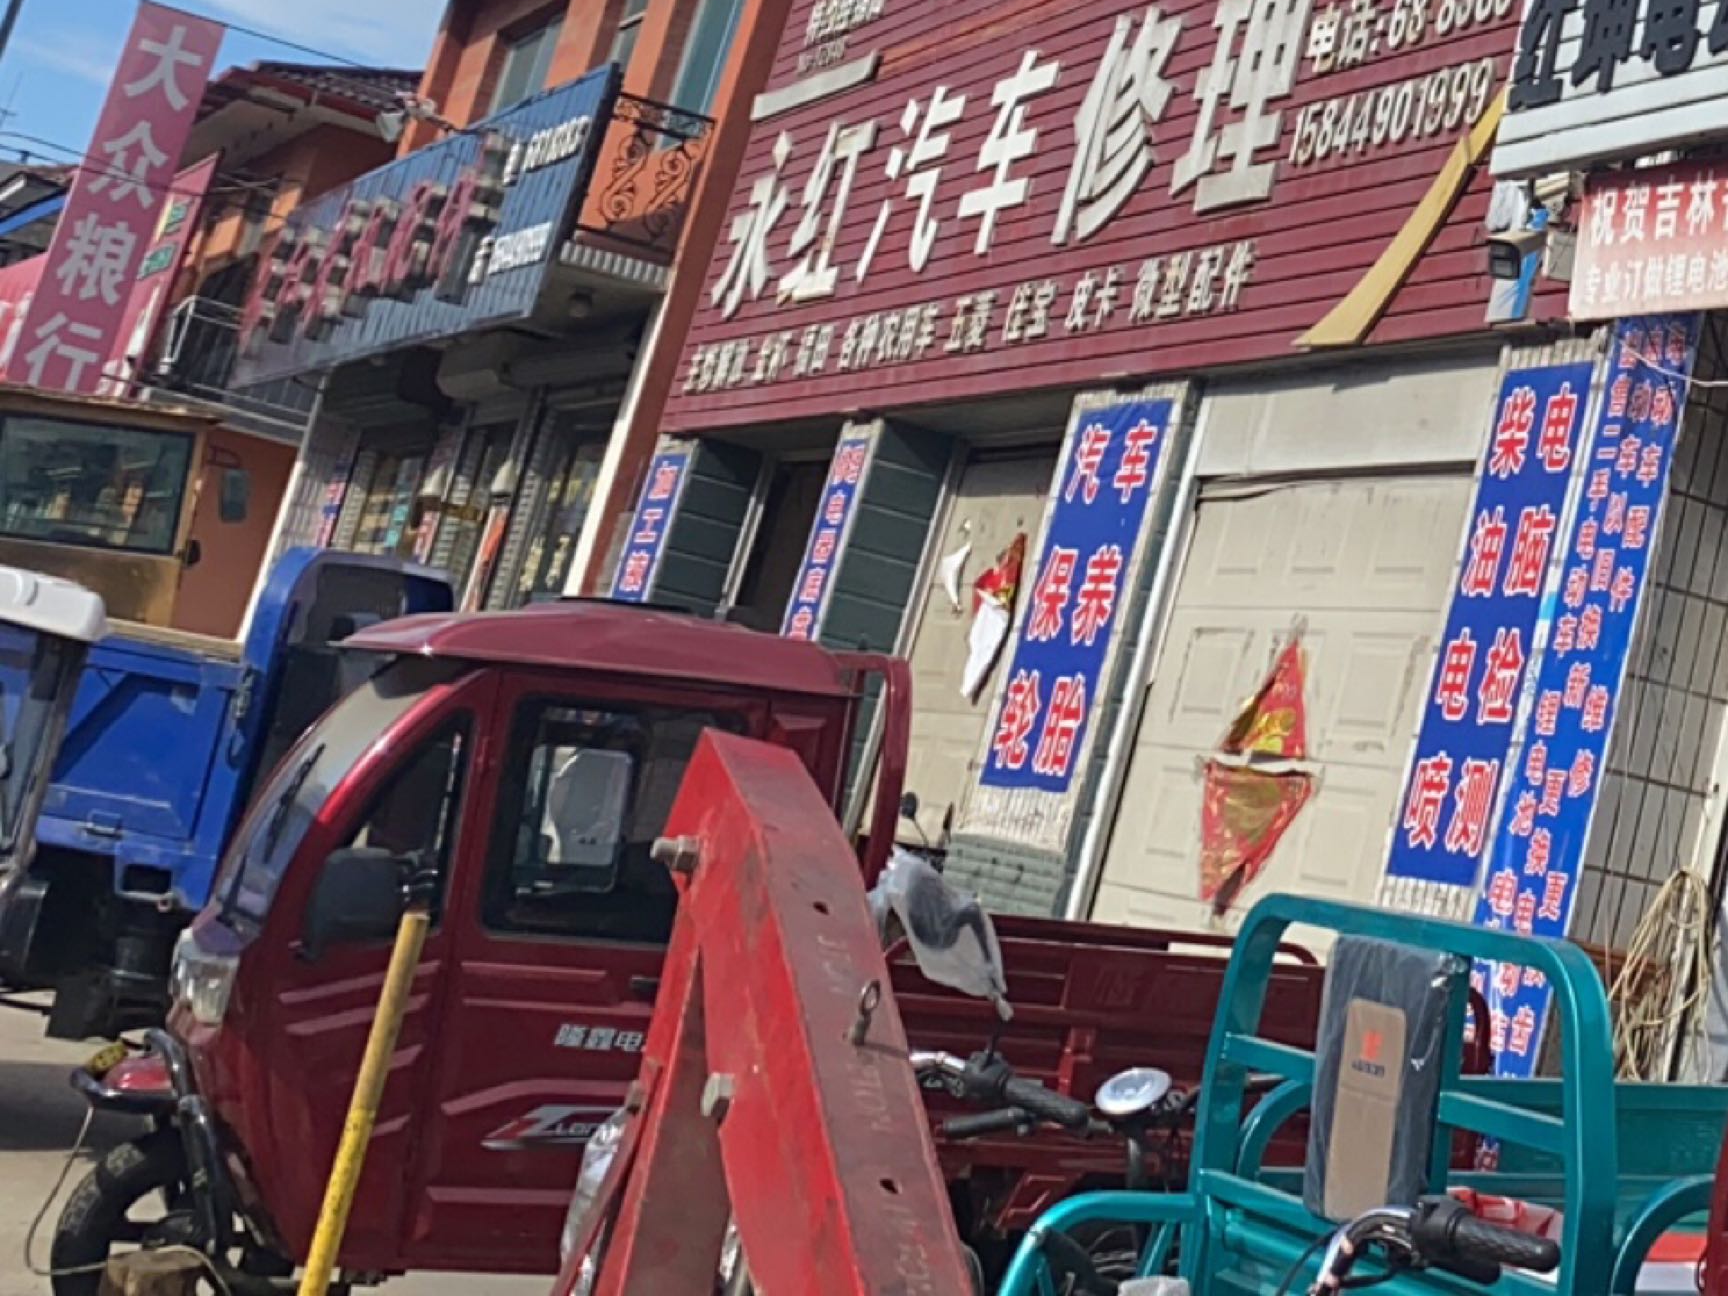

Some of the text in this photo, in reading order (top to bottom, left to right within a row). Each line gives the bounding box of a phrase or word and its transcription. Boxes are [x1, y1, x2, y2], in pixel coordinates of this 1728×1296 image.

[1287, 57, 1496, 165] 15844901999
[24, 24, 204, 392] 大众粮行
[1063, 417, 1159, 505] 汽车
[1026, 544, 1125, 647] 保养
[993, 668, 1087, 778] 轮胎
